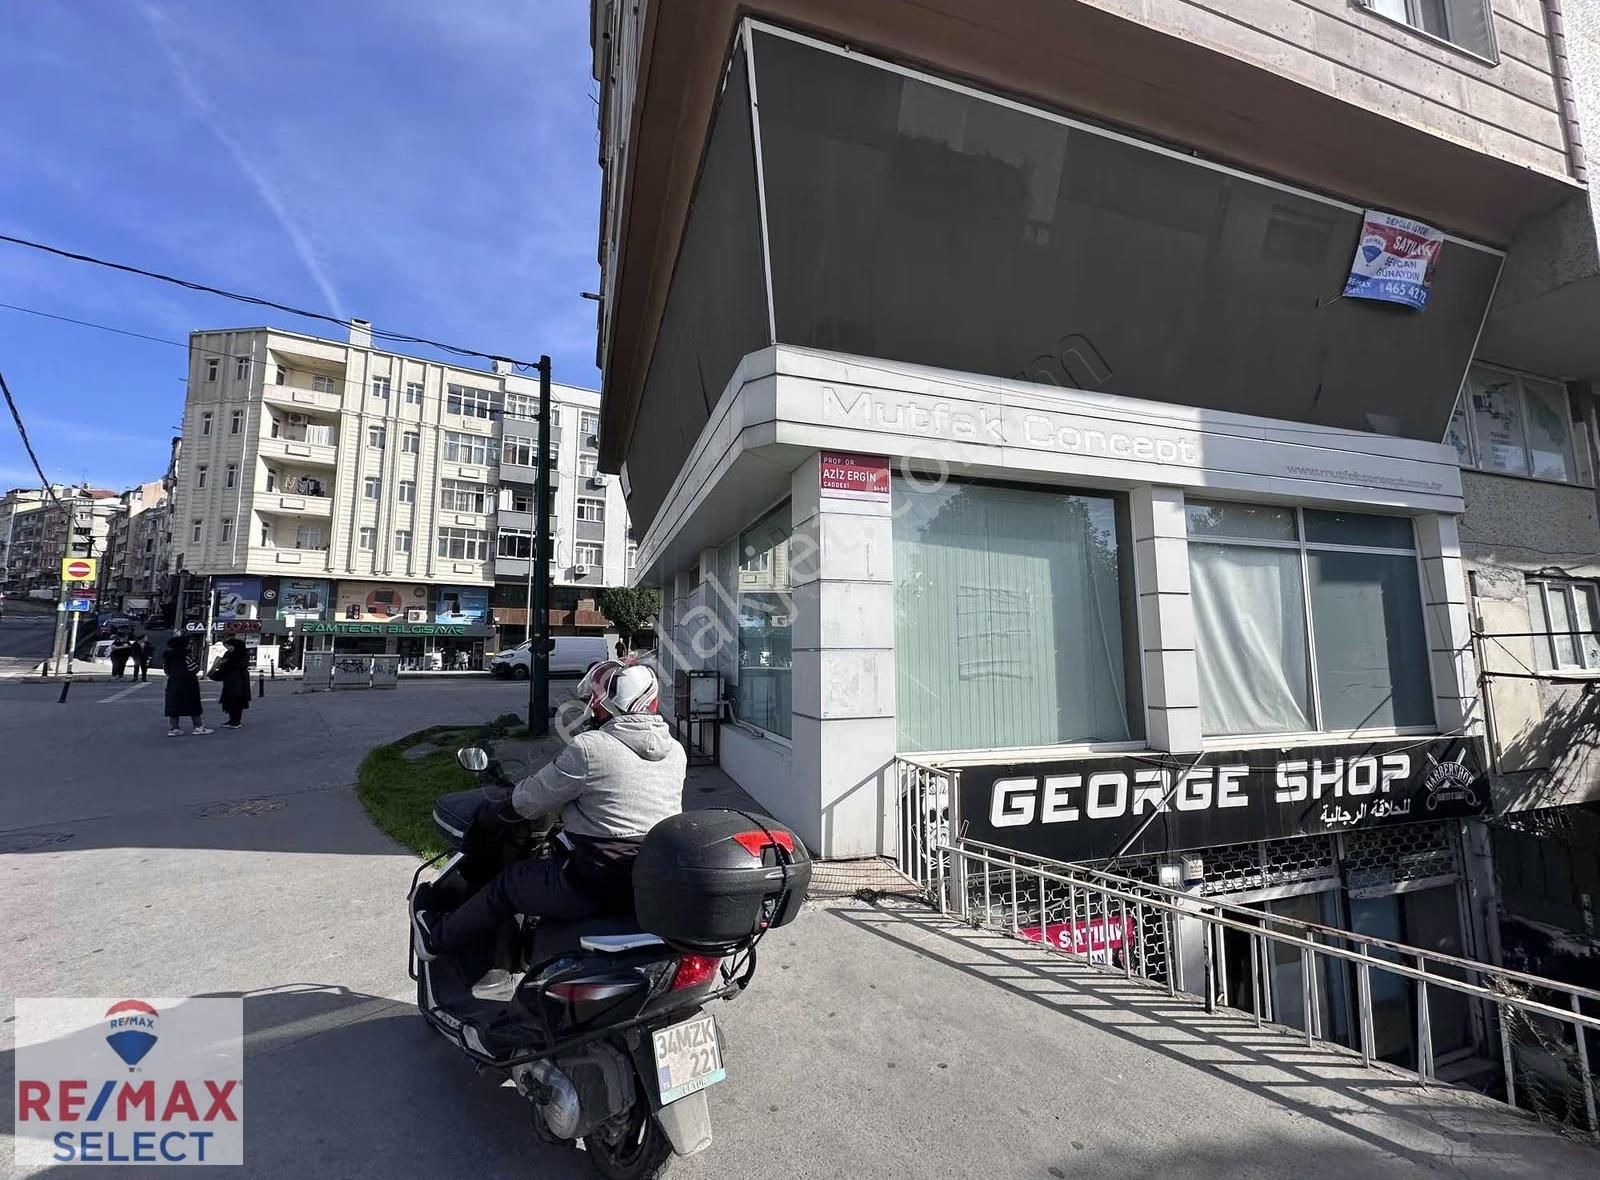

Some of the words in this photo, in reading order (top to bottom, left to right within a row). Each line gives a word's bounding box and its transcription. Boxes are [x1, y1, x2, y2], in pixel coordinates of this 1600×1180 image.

[822, 386, 1008, 443] Mutfak
[1023, 413, 1199, 465] Concept
[823, 468, 845, 480] AZİZ
[847, 471, 876, 483] ERGİN
[302, 623, 382, 634] RAMTECH
[989, 765, 1250, 828] GEORGE
[1275, 753, 1411, 804] SHOP
[656, 1019, 715, 1060] 34MZK
[689, 1047, 719, 1078] 221
